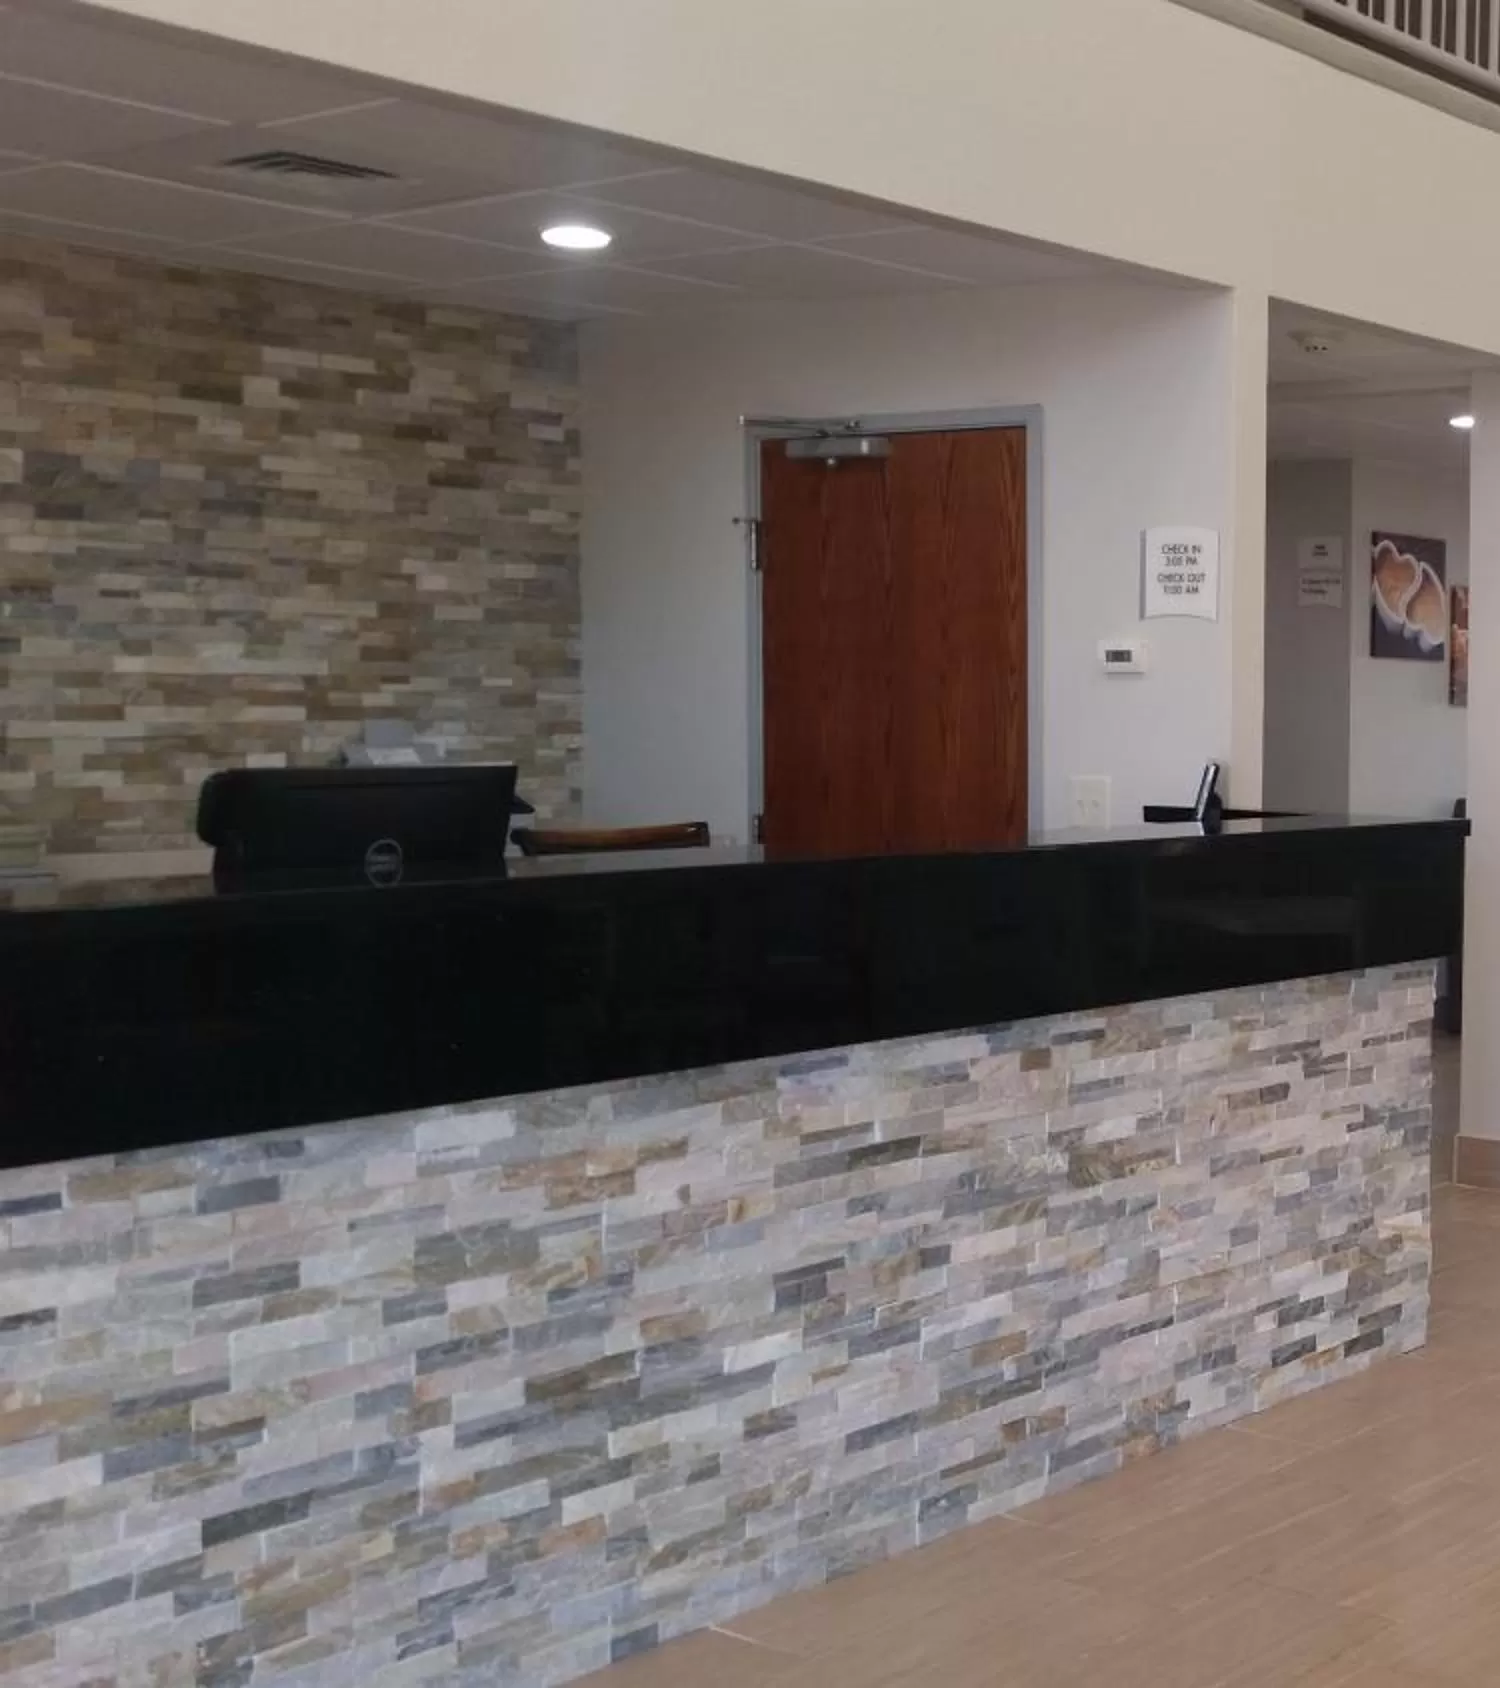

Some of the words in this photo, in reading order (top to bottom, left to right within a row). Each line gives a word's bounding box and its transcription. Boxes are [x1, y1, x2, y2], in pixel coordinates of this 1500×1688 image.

[1160, 544, 1189, 555] CHECK
[1191, 544, 1203, 555] IN
[1186, 556, 1199, 566] PM
[1157, 572, 1185, 583] CHECK
[1187, 572, 1206, 583] OUT
[1185, 585, 1200, 594] AM
